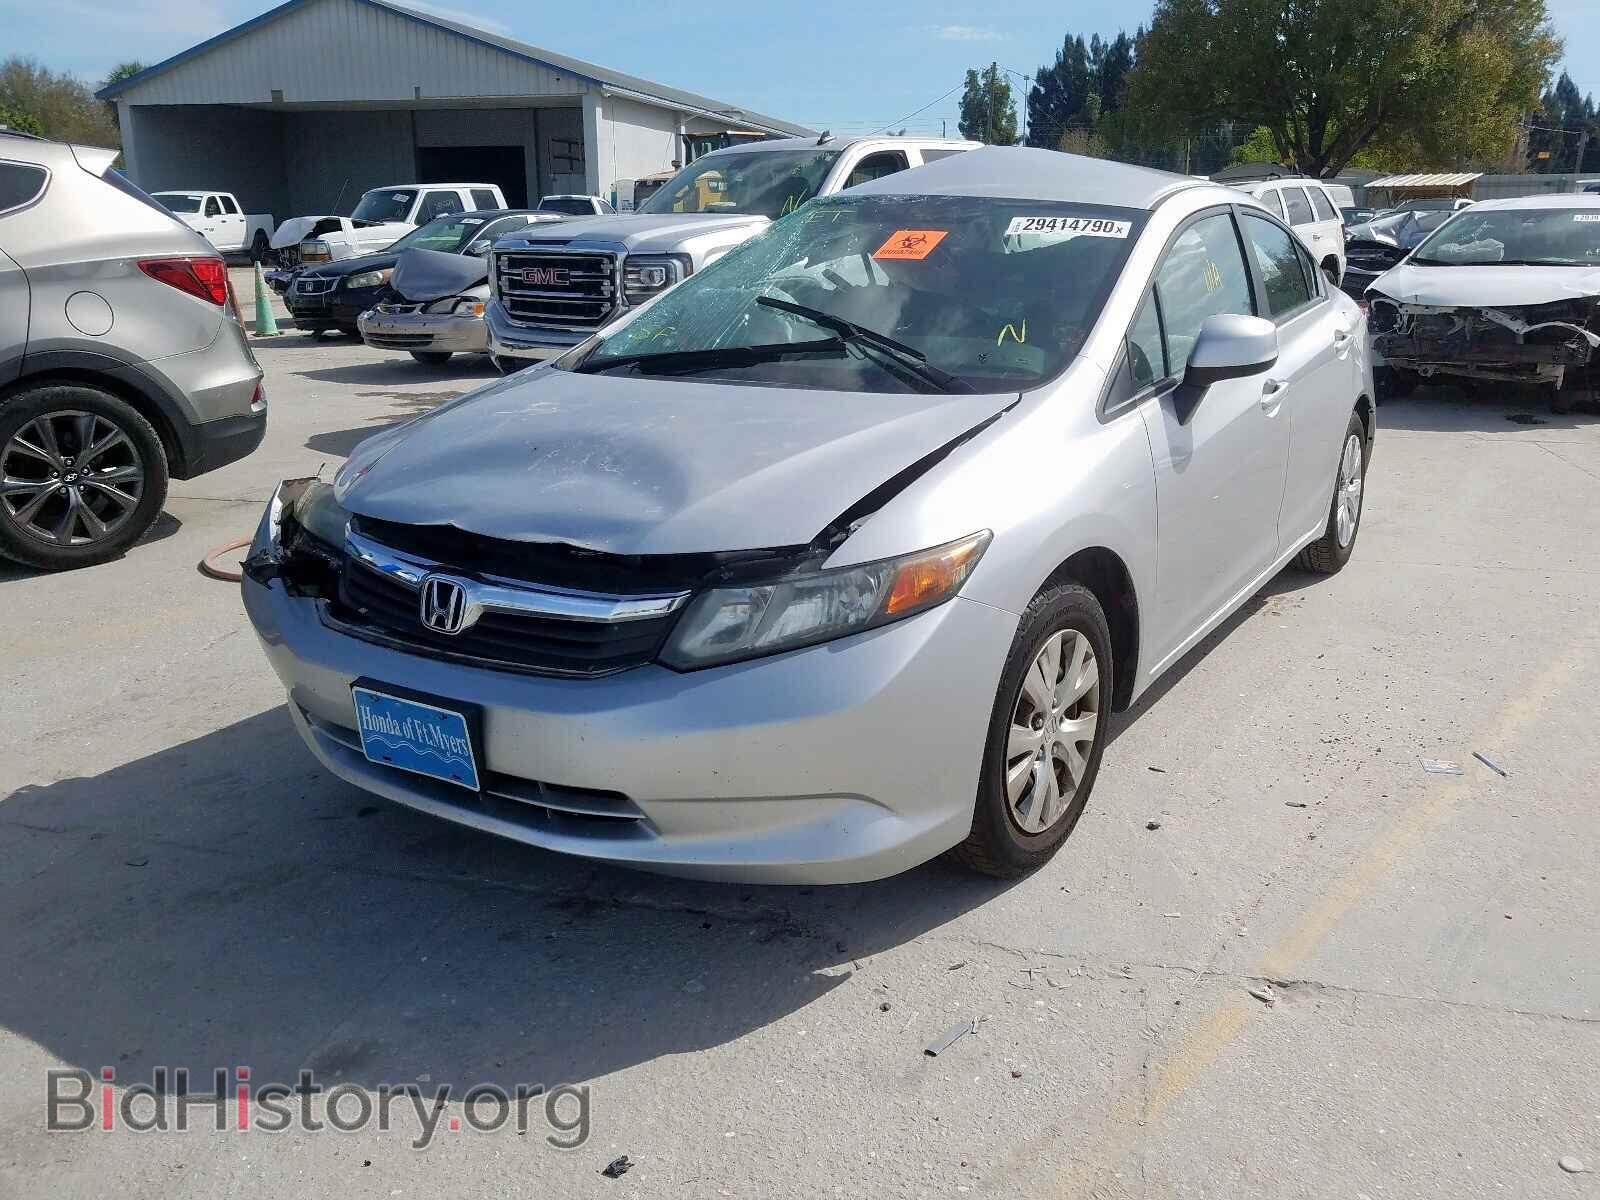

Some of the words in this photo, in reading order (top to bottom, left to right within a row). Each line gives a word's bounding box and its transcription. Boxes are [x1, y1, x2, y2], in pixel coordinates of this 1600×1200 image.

[521, 267, 570, 286] GMC
[360, 705, 401, 736] Honda
[402, 717, 417, 739] of
